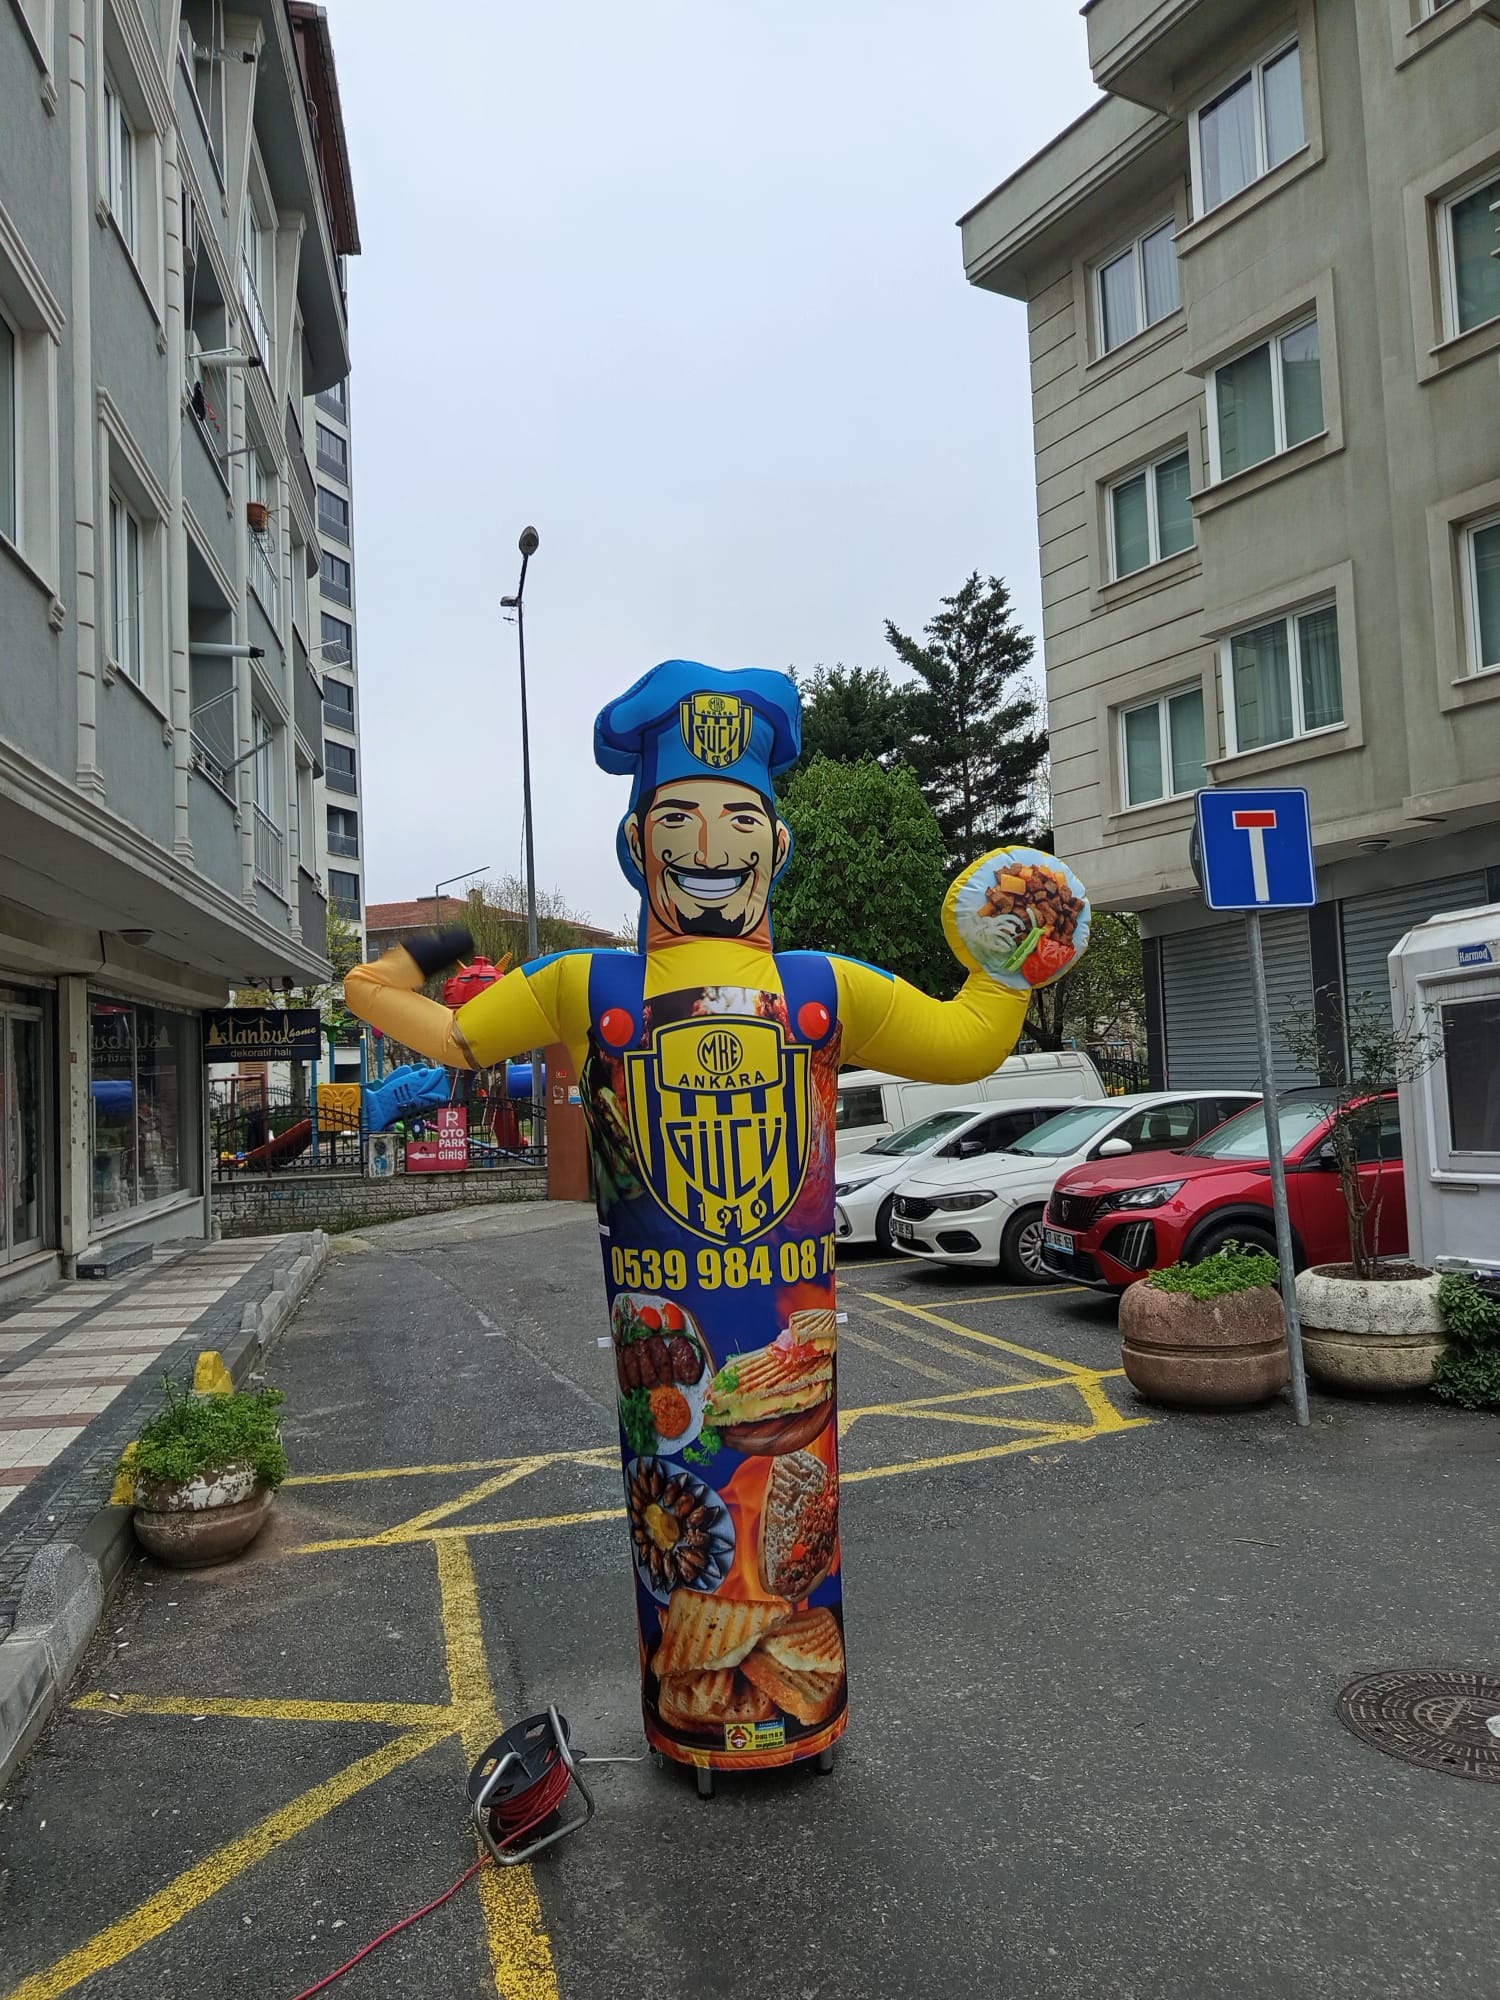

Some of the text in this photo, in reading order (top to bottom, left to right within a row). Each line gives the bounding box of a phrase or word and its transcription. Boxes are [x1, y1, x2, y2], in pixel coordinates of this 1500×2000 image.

[1459, 948, 1489, 963] Karmod
[230, 1048, 272, 1058] dekoratif
[702, 1034, 738, 1071] MKE
[678, 1070, 766, 1089] ANKARA
[440, 1129, 465, 1138] OTO
[439, 1138, 466, 1148] PARK
[697, 1199, 768, 1230] 1910
[611, 1246, 688, 1290] 0539
[697, 1245, 773, 1290] 984
[780, 1239, 817, 1283] 08
